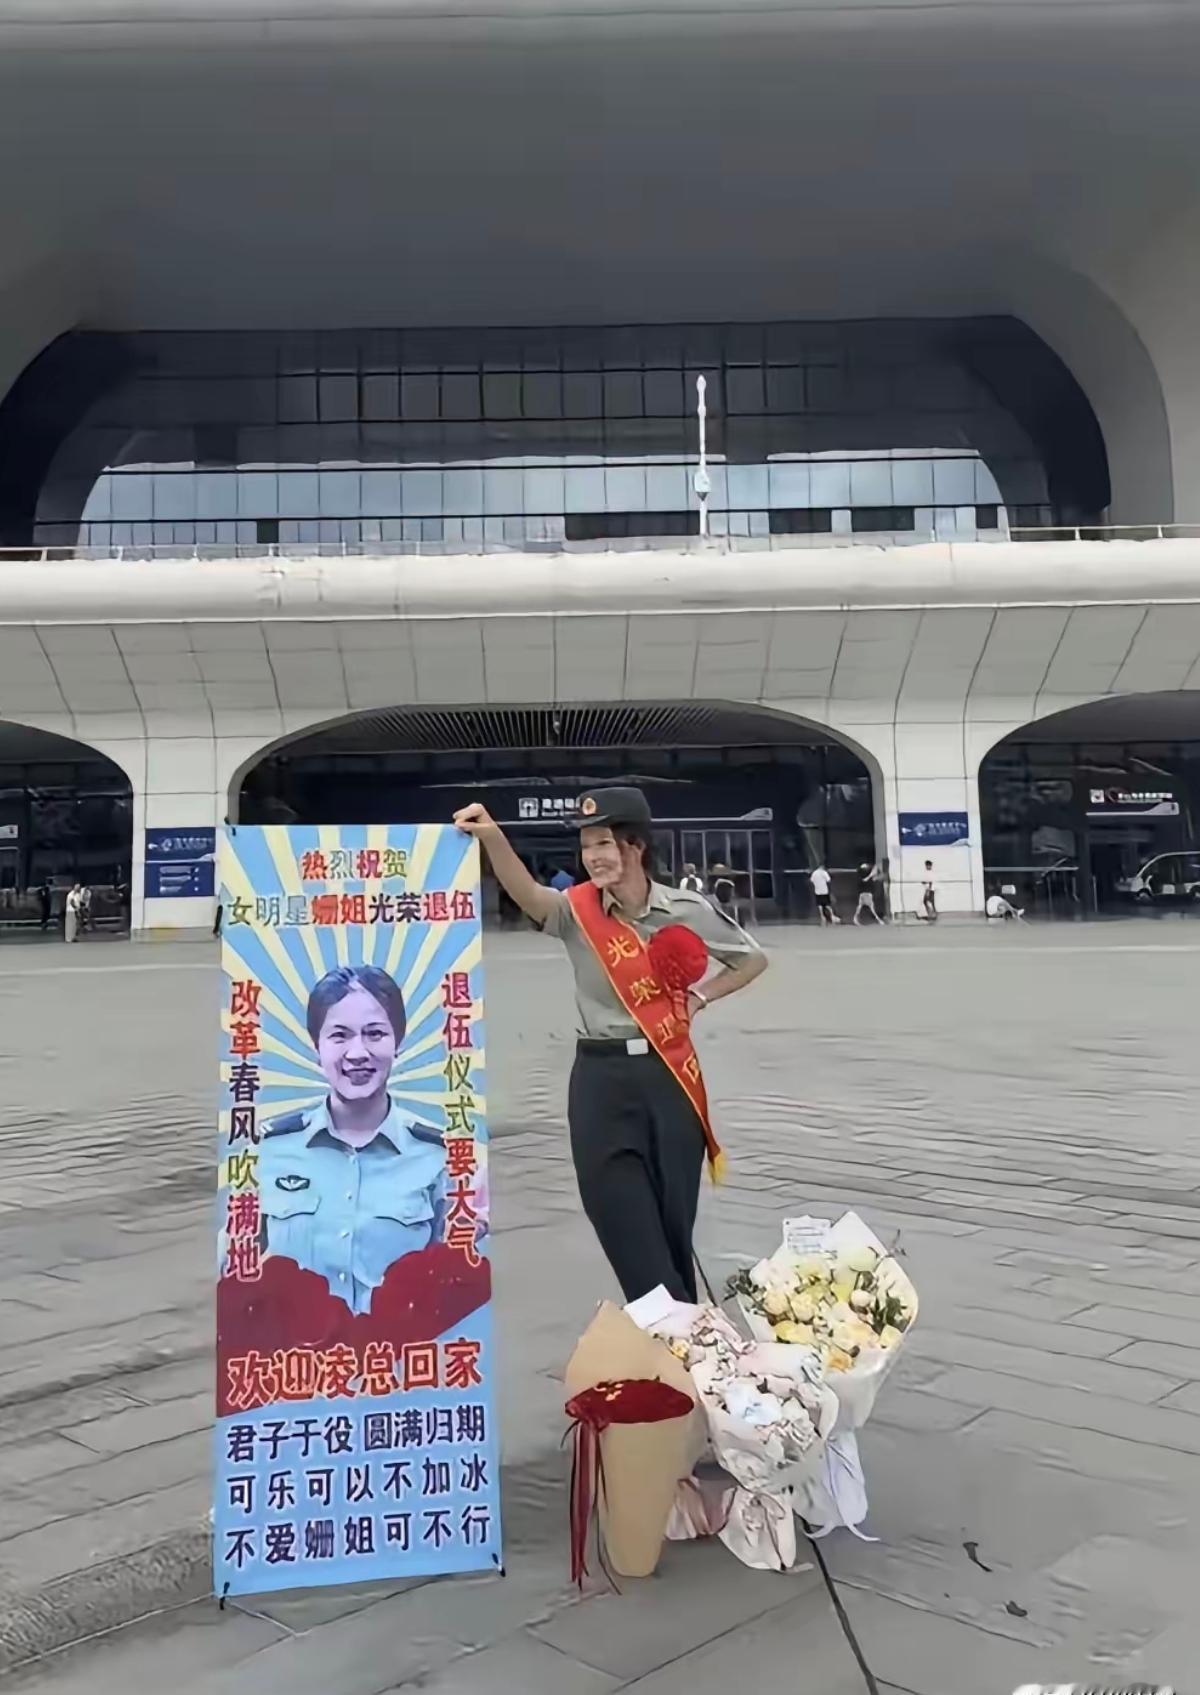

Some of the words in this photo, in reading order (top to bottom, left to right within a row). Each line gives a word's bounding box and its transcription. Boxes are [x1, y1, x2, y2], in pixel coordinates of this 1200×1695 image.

[302, 849, 408, 881] 热烈祝贺
[226, 890, 476, 926] 女明星姗姐光荣退伍
[226, 979, 262, 1281] 改革春风吹满地
[441, 972, 480, 1267] 退伍仪式要大气
[226, 1337, 483, 1408] 欢迎凌总回家
[226, 1453, 489, 1514] 可乐可以不加冰
[225, 1505, 491, 1568] 不爱姗姐可不行
